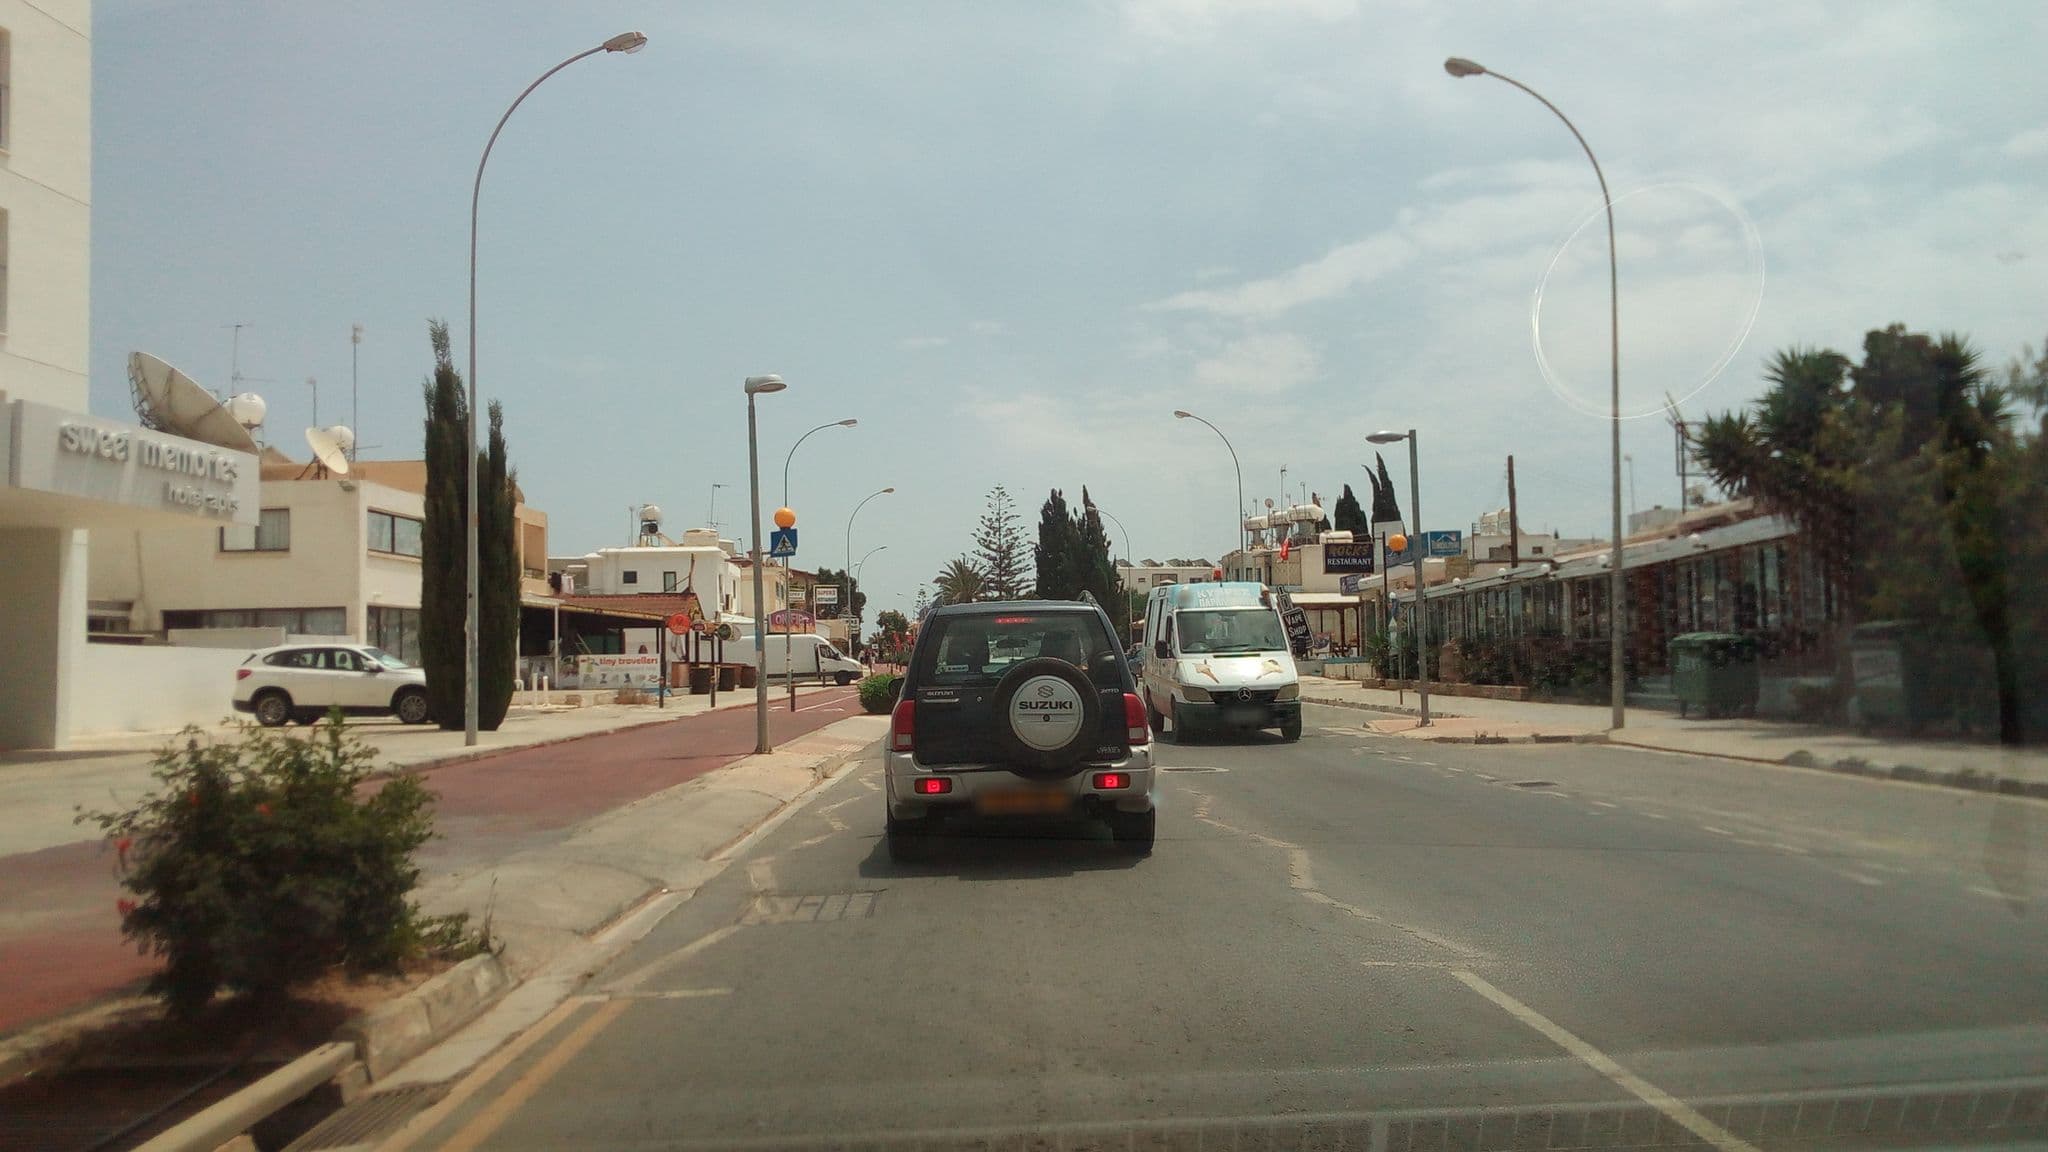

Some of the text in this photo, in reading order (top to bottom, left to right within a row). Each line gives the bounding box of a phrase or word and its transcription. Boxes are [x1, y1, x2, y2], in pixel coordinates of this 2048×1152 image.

[138, 438, 240, 483] memories
[1327, 557, 1372, 566] RESTAURANT
[599, 656, 658, 666] tiny travellers
[1018, 700, 1073, 710] SUZUKI
